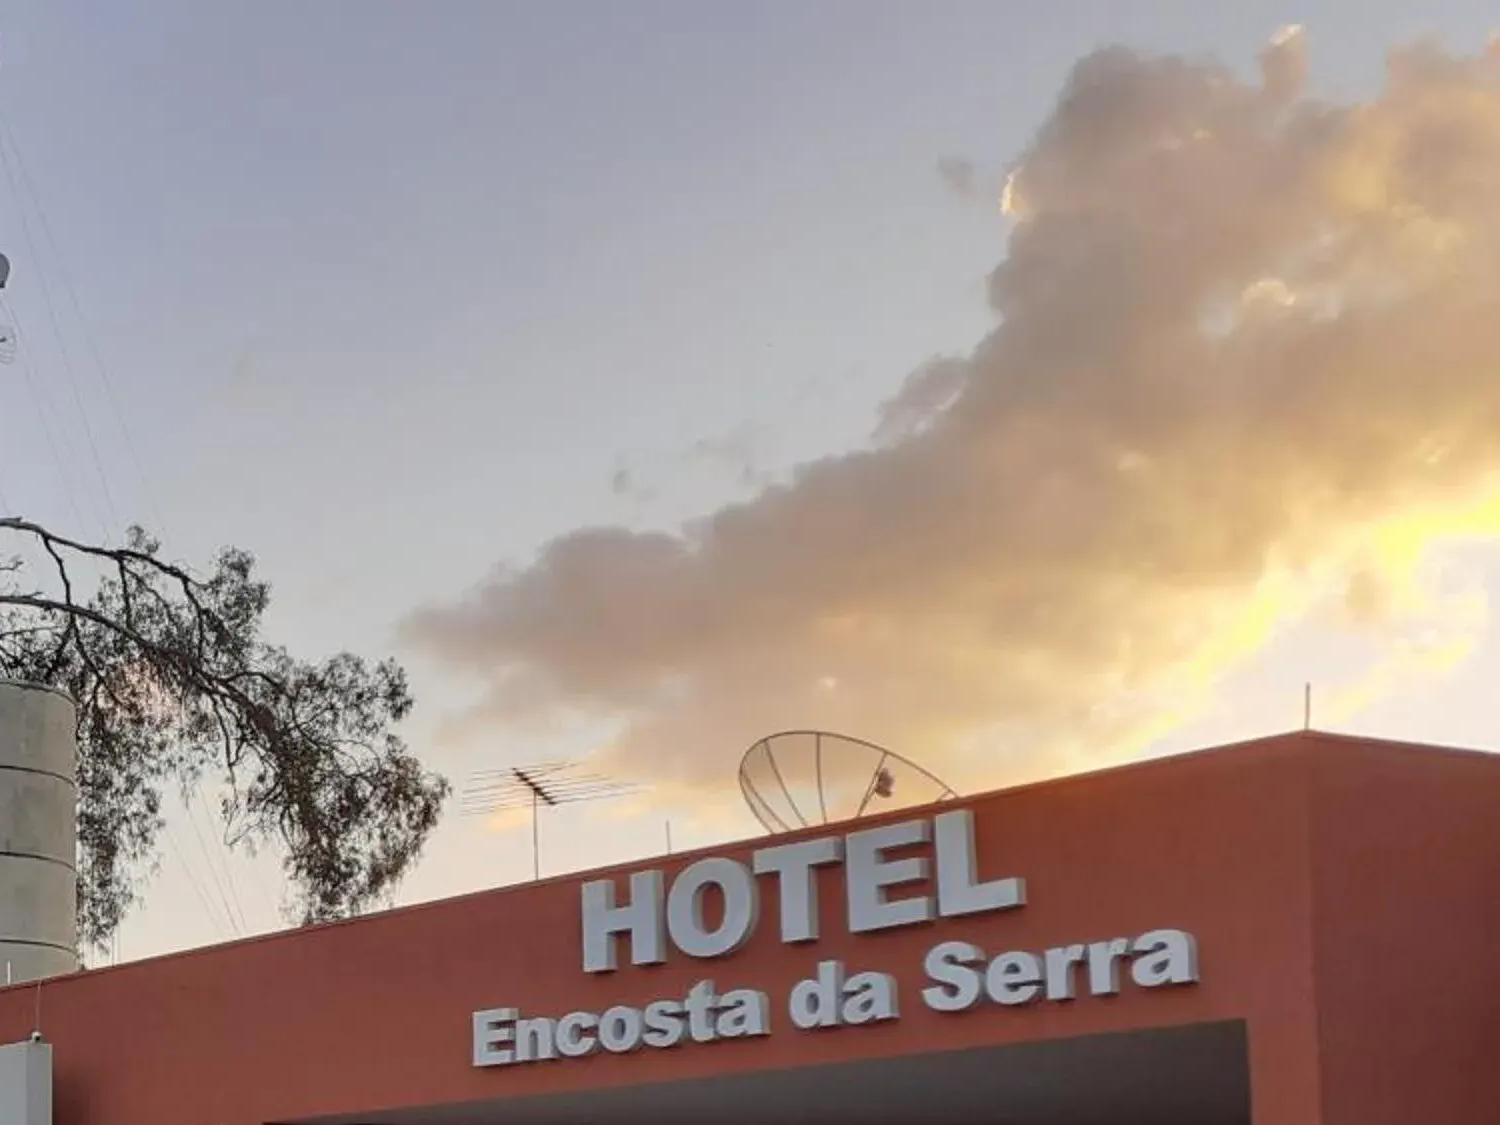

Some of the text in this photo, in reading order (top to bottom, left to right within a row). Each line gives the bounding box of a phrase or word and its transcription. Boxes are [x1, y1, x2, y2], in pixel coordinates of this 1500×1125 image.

[581, 809, 1026, 974] HOTEL
[472, 928, 1200, 1067] Encosta da Serra
